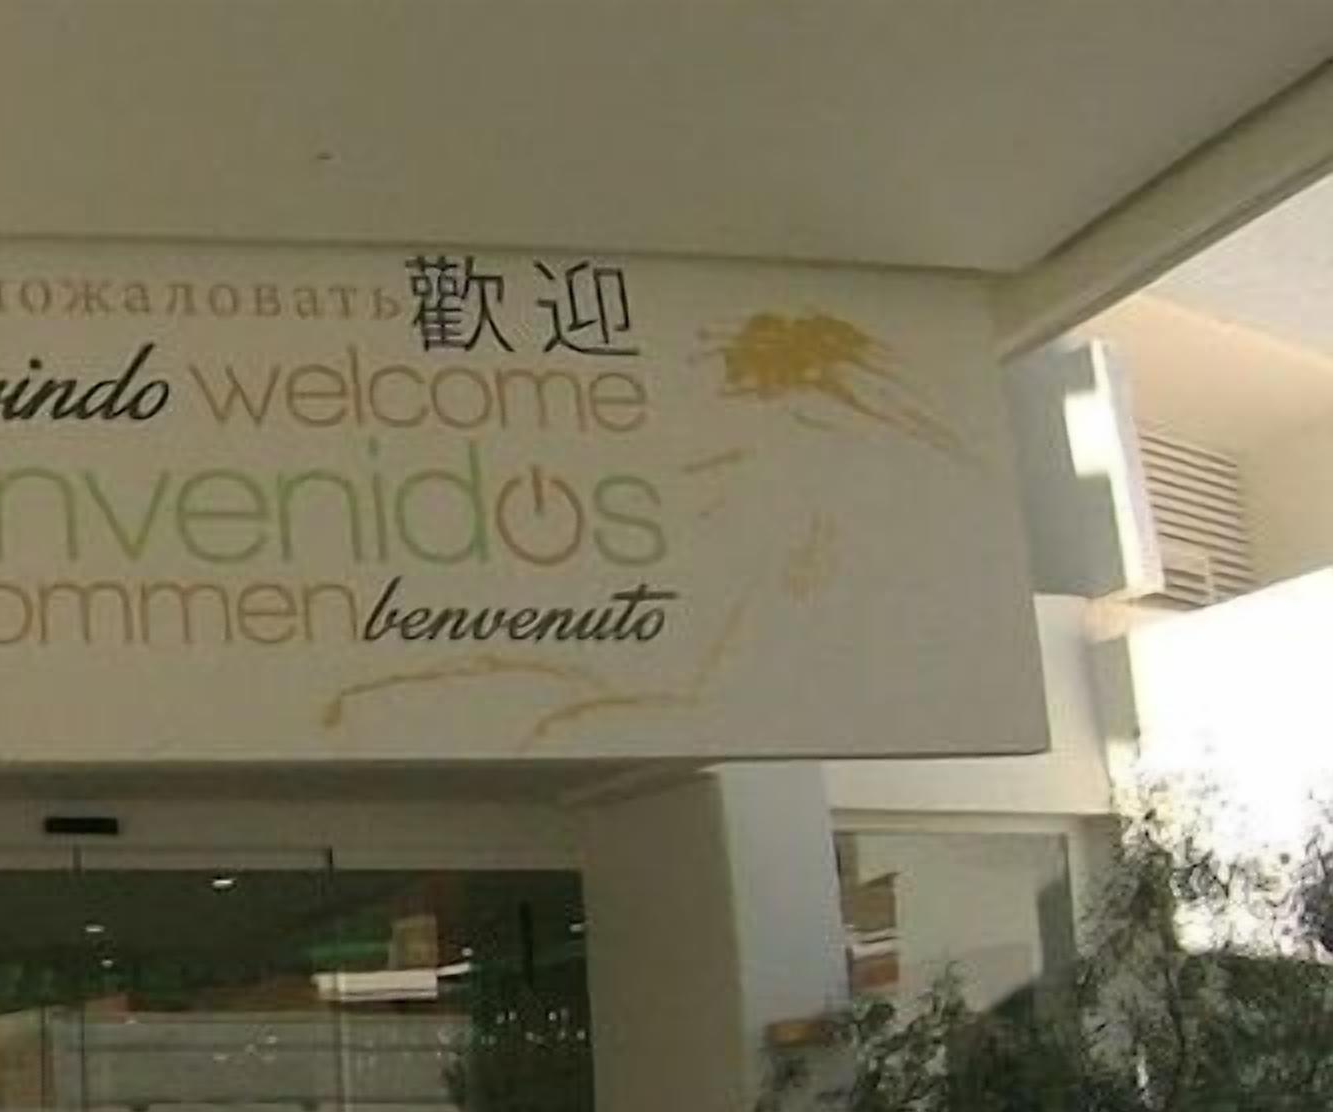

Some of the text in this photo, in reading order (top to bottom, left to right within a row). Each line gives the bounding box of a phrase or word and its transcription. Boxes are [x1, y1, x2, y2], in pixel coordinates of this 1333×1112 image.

[405, 254, 640, 357] 歡迎
[188, 344, 649, 432] welcome
[362, 575, 679, 643] benvenuto
